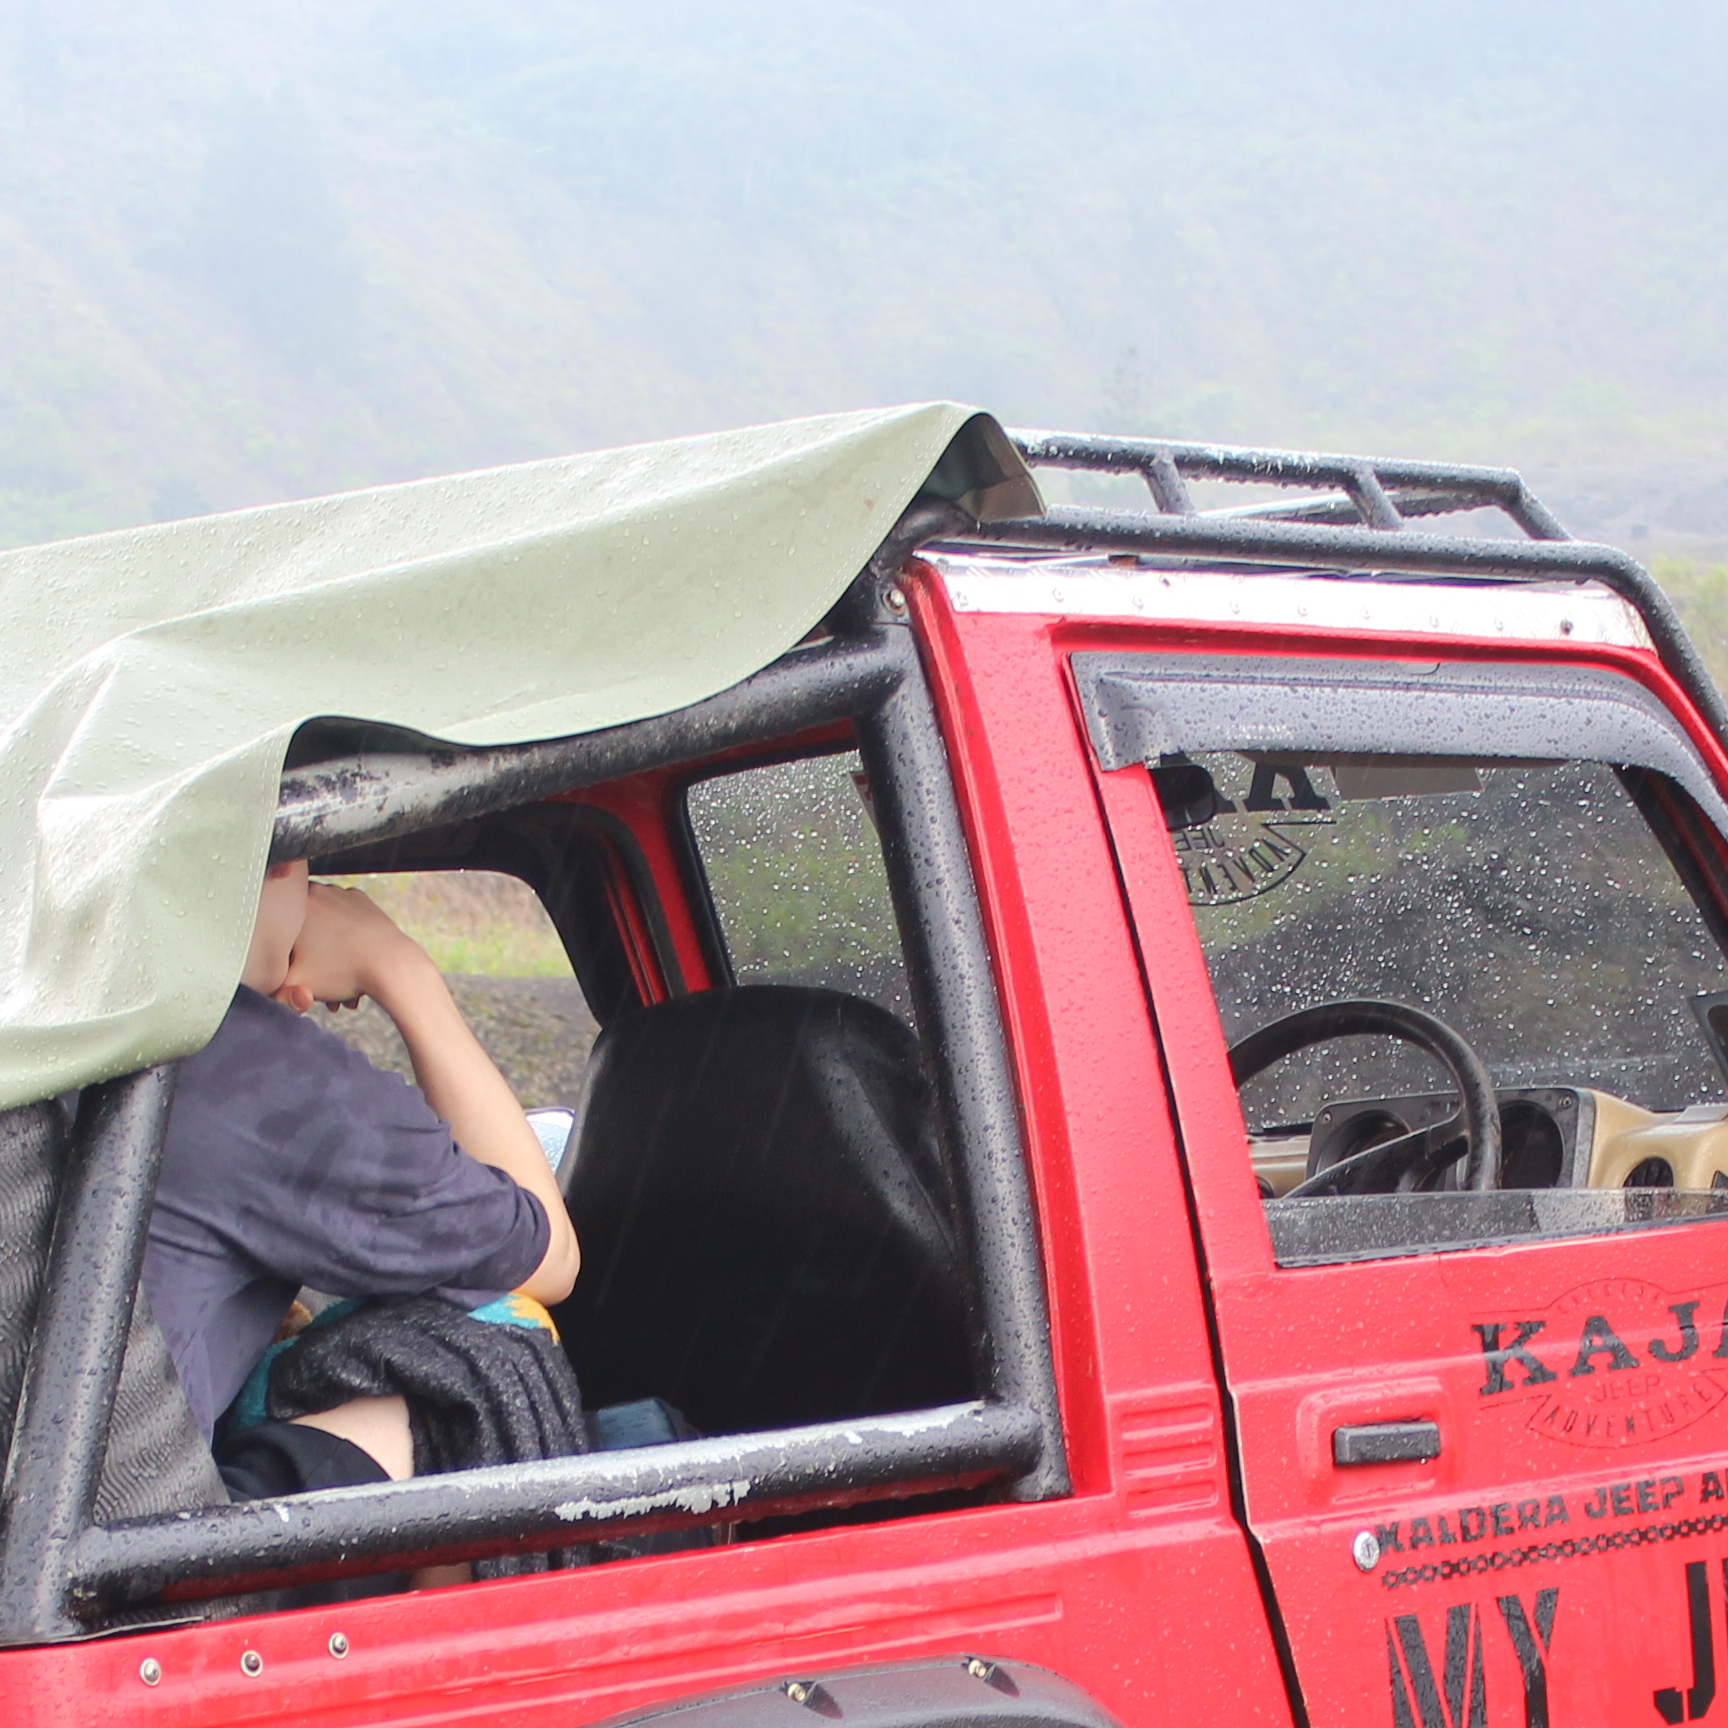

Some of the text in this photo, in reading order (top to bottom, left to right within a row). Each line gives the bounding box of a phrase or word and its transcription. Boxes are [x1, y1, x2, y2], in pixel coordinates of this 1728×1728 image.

[1544, 1378, 1712, 1439] ADVENTURE
[1593, 1374, 1661, 1403] JEEP
[1375, 1495, 1570, 1555] KALDERA
[1583, 1475, 1685, 1520] JEEP
